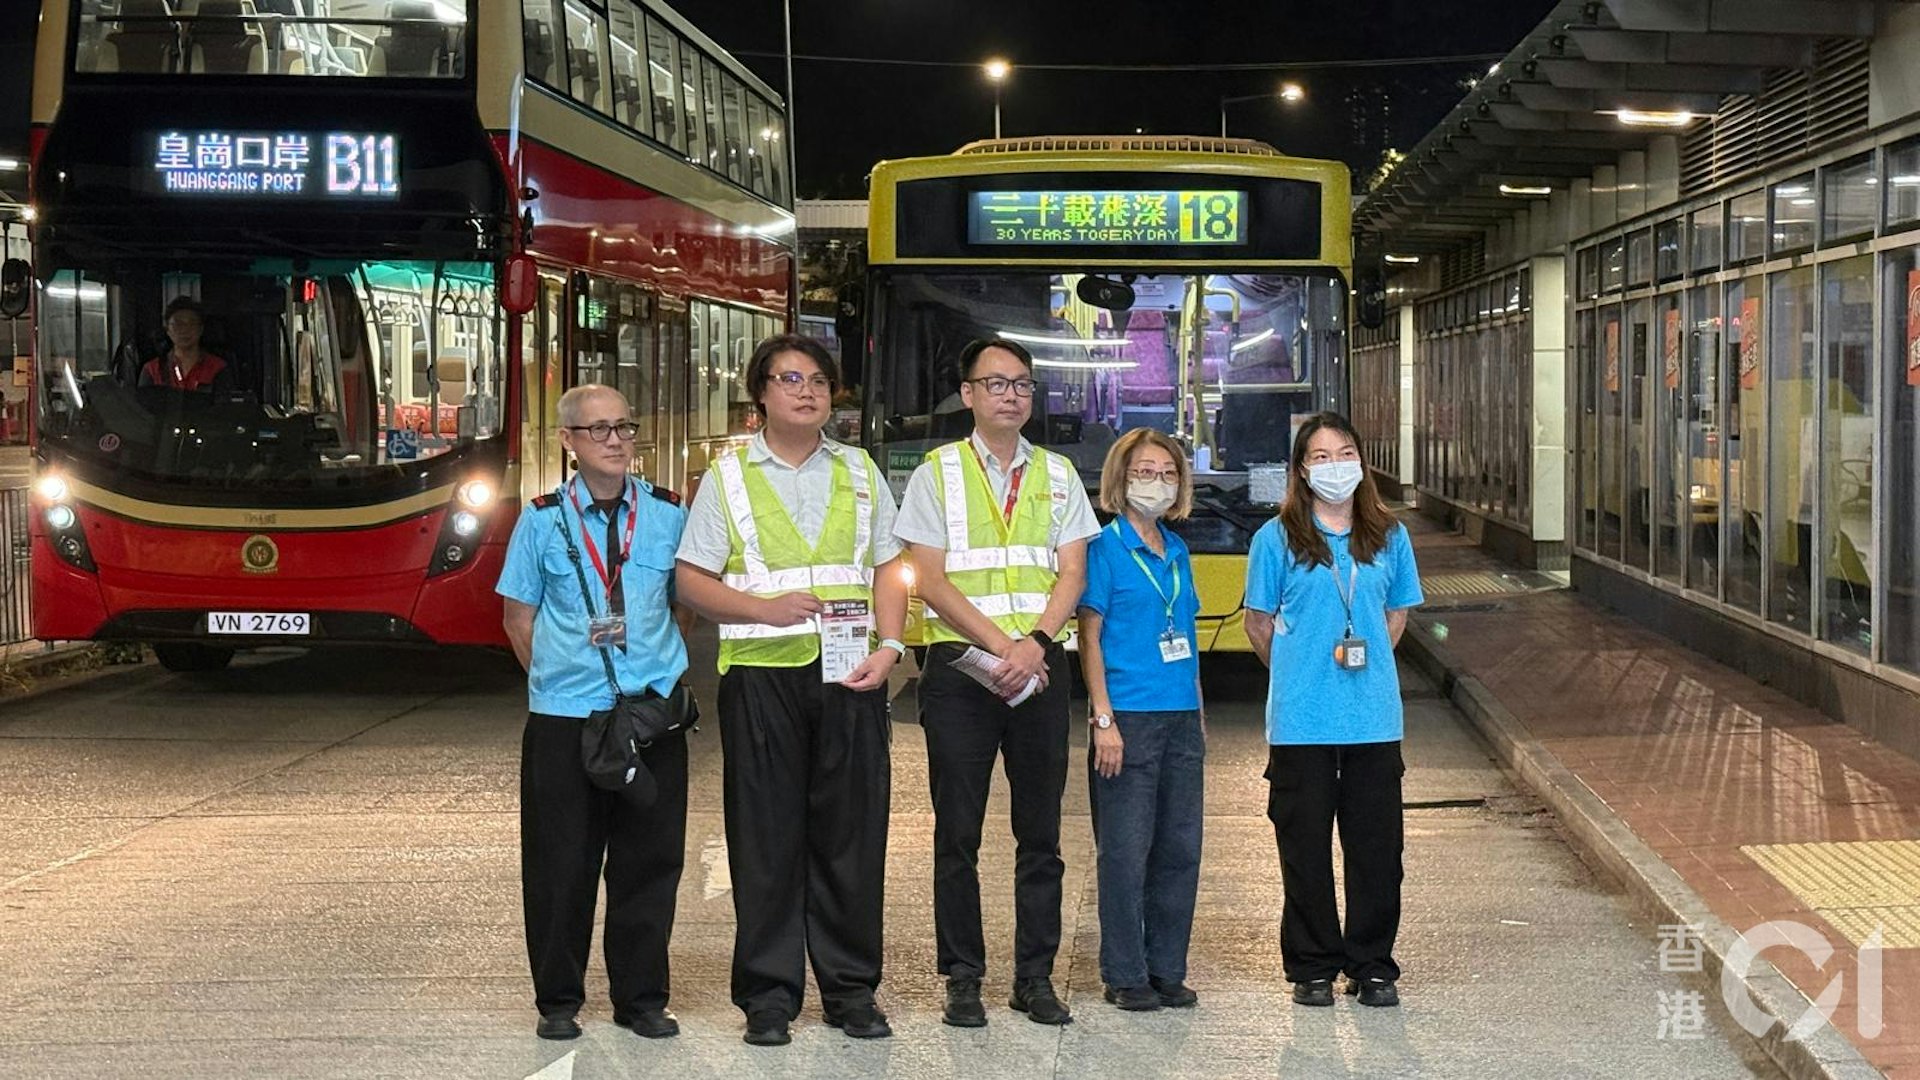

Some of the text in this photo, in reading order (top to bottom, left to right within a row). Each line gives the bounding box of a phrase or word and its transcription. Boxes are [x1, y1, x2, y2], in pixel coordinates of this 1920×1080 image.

[155, 132, 310, 170] 皇崗口岸
[327, 134, 398, 193] B11
[166, 171, 306, 191] HUANGGANG PORT
[1183, 194, 1233, 240] 18
[996, 228, 1016, 240] 30
[1020, 228, 1072, 240] YEARS
[214, 614, 305, 632] VN 2769
